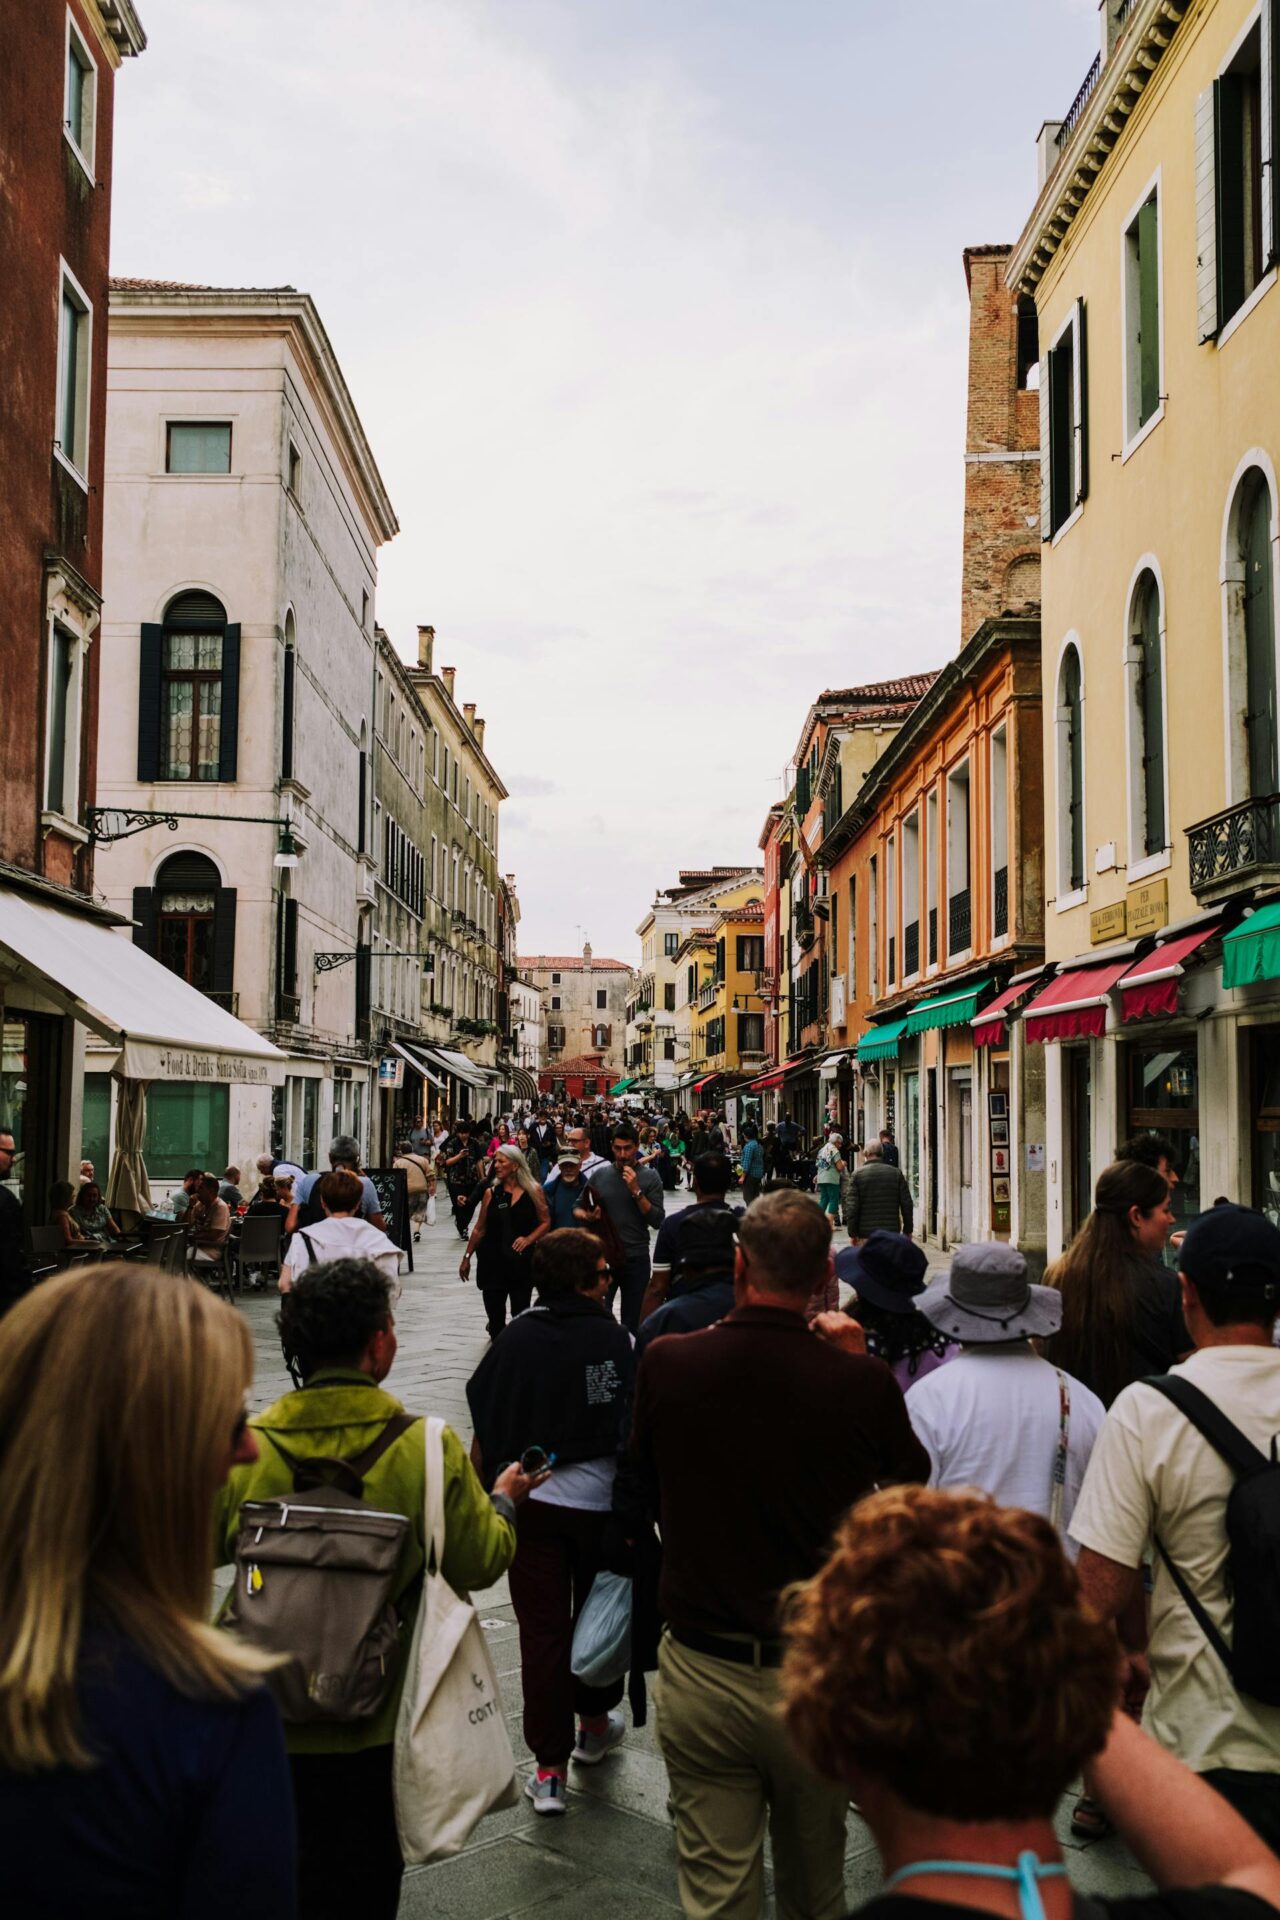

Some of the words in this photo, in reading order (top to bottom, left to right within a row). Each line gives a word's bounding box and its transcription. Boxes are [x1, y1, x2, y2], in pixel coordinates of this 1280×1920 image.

[1140, 890, 1149, 904] PER
[1149, 901, 1164, 915] ROMA
[167, 1051, 183, 1075] Food
[185, 1054, 191, 1075] &
[192, 1055, 214, 1077] Drinks
[216, 1056, 232, 1078] Santa
